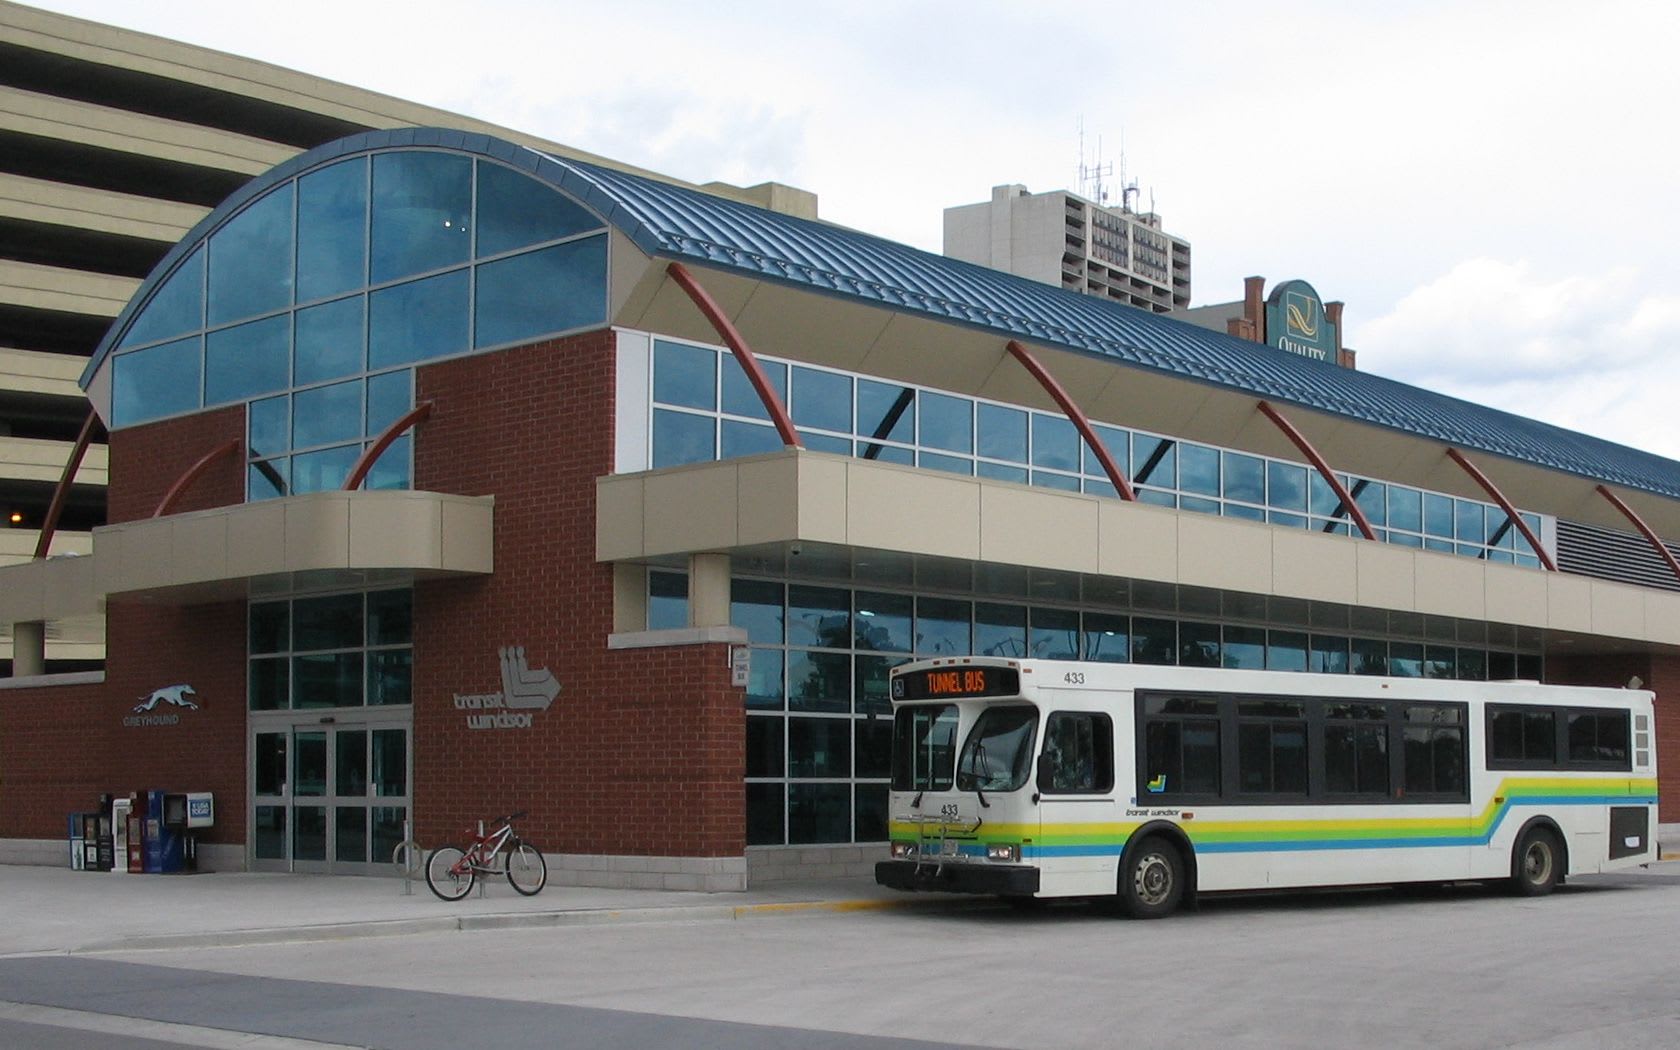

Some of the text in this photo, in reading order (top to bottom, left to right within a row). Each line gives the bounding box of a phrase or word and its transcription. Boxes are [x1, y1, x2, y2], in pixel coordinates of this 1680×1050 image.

[927, 671, 985, 694] TUNNEL BUS
[1064, 672, 1085, 685] 433
[453, 691, 506, 710] transit
[122, 714, 180, 728] GREYHOUND
[467, 710, 534, 729] windsor
[941, 804, 958, 816] 433
